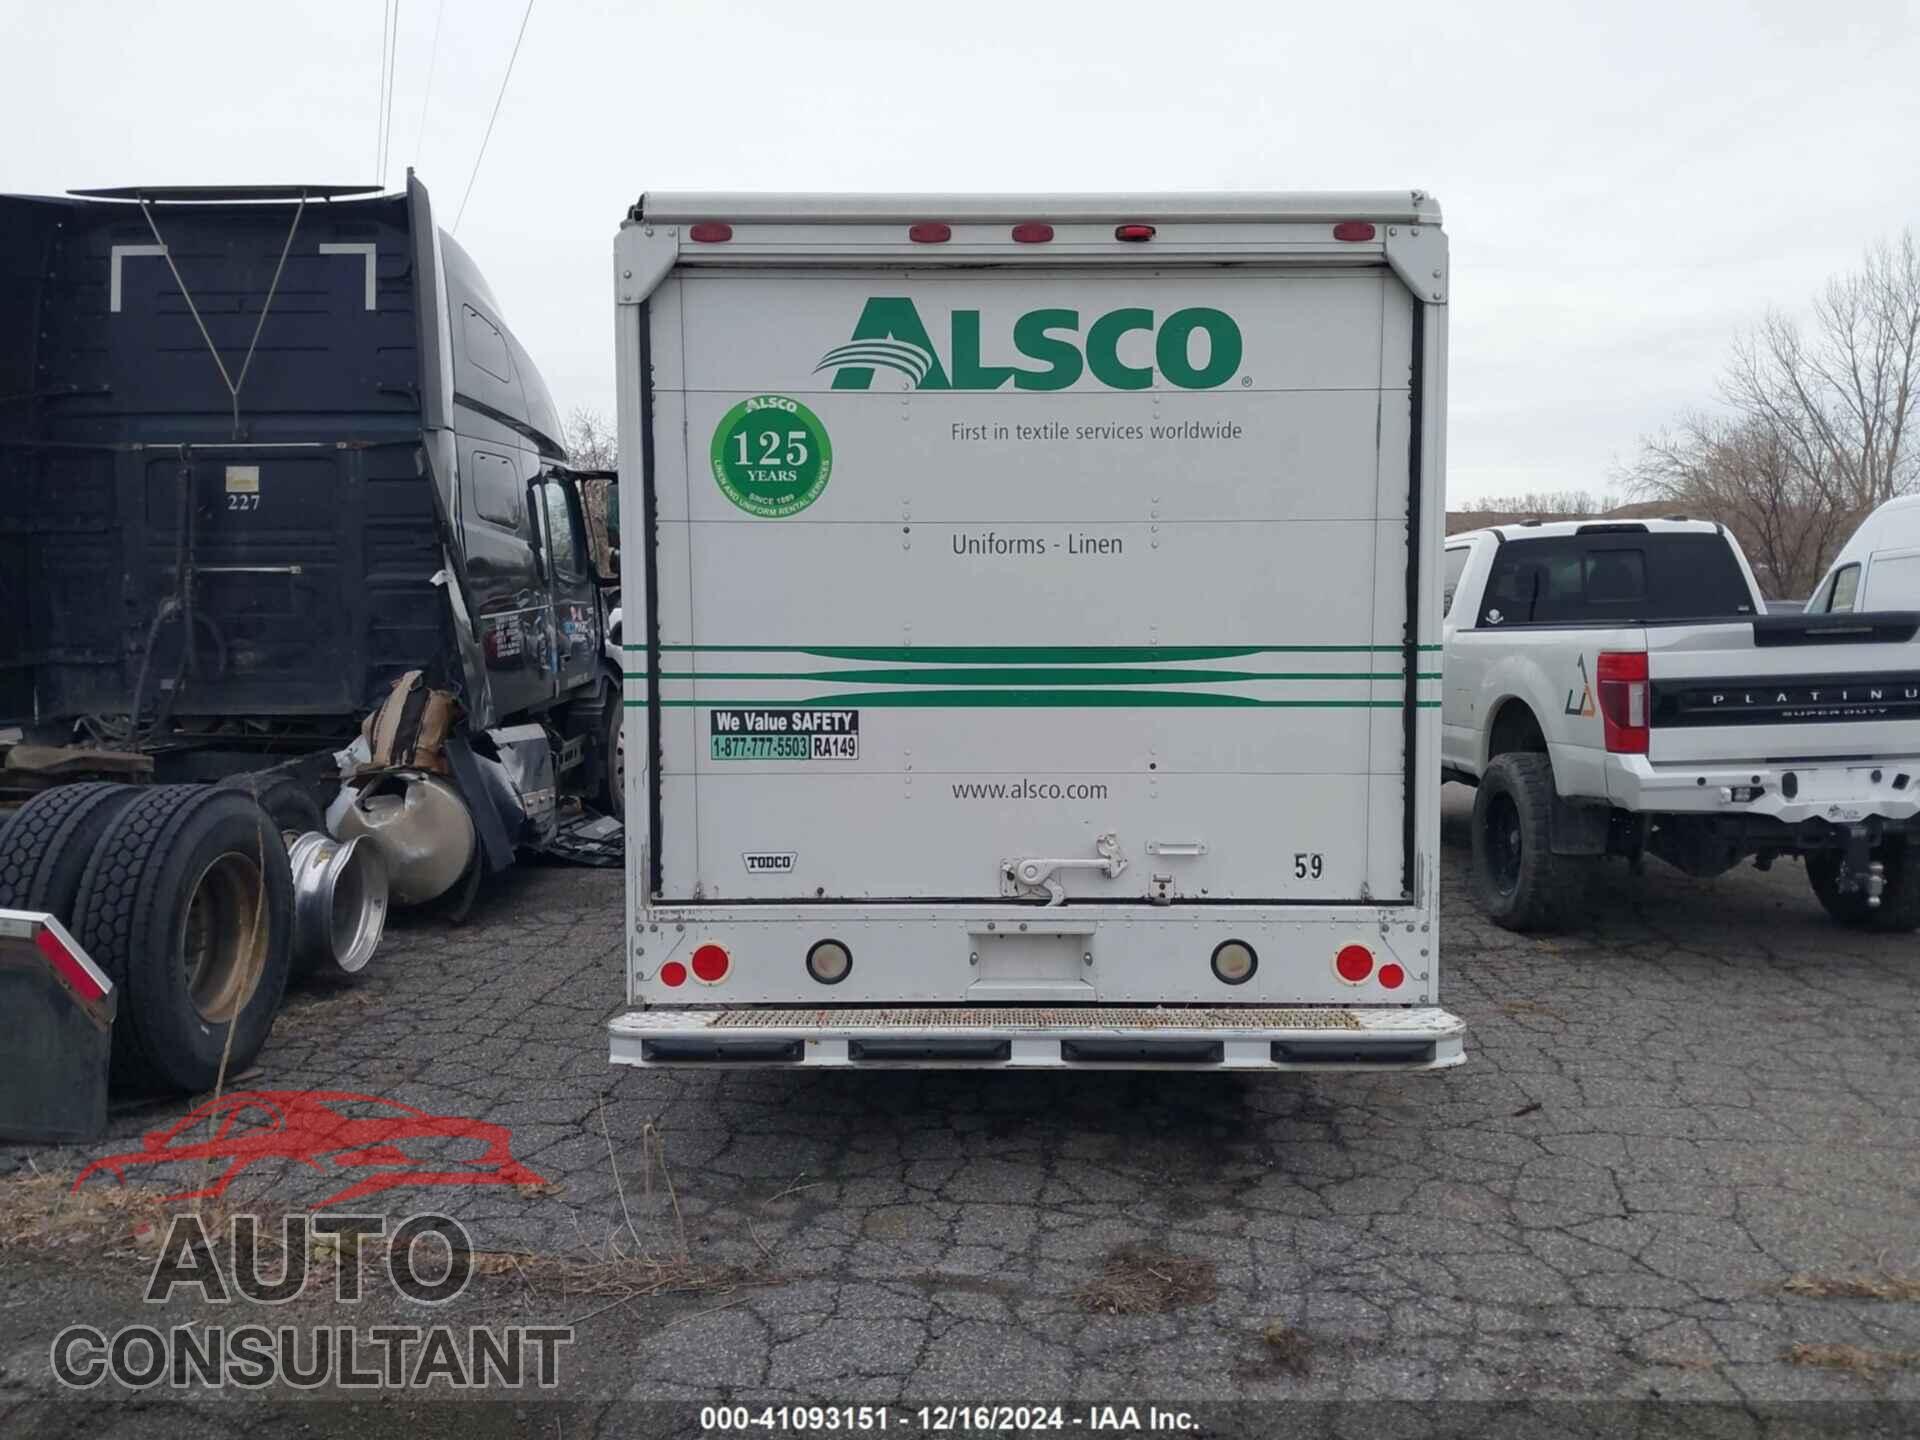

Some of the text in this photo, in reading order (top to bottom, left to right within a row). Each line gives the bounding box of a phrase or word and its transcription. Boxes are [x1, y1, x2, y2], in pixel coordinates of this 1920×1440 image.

[813, 296, 1243, 391] ALSCO
[745, 397, 798, 413] ALSCO
[951, 421, 1242, 440] First in textile services worldwide
[733, 431, 808, 466] 125
[747, 470, 797, 482] YEARS
[227, 494, 260, 510] 227
[952, 532, 1046, 554] Uniforms
[1068, 533, 1122, 554] Linen
[716, 712, 852, 731] We Value SAFETY
[713, 736, 807, 757] 1-877-777-5503
[814, 736, 856, 757] RA149
[952, 778, 1108, 800] www.alsco.com
[747, 855, 790, 869] TODCO
[1294, 853, 1322, 879] 59
